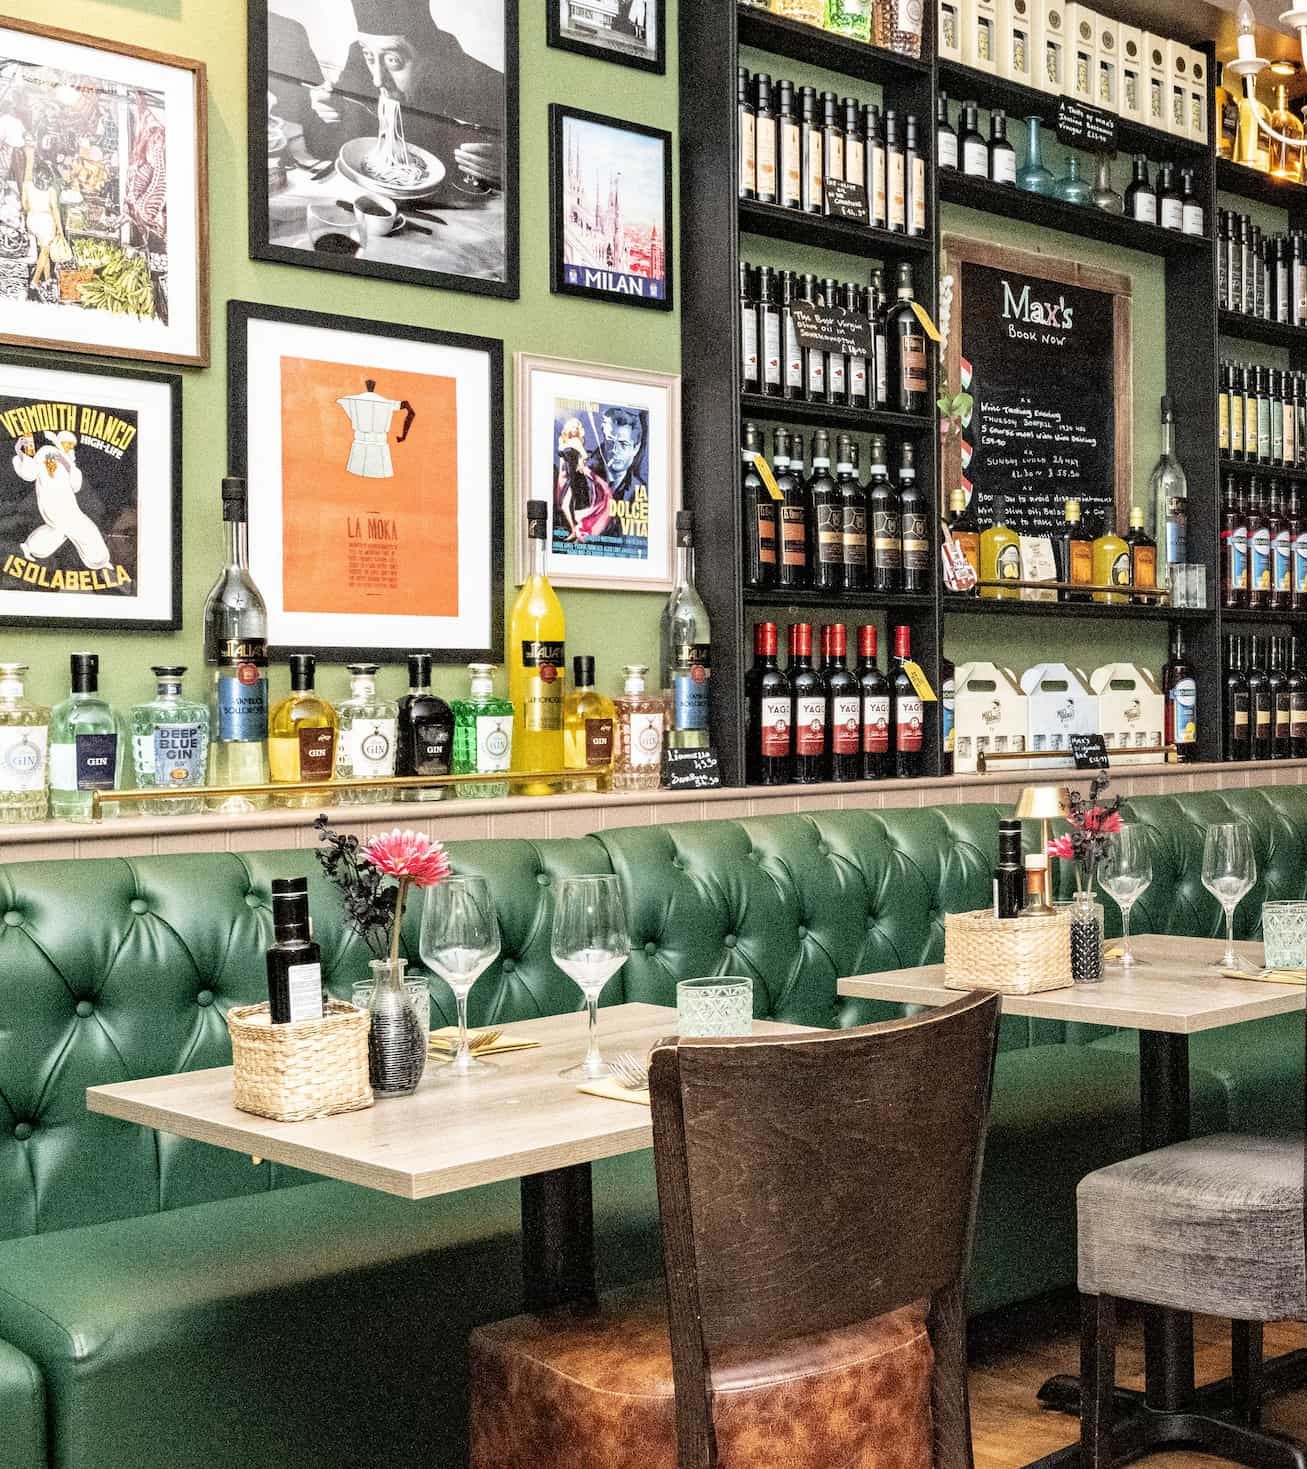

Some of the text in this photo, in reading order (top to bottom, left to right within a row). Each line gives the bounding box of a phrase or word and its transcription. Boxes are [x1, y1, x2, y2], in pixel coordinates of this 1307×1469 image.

[584, 268, 644, 297] MILAN
[1001, 281, 1074, 329] Max's
[0, 403, 136, 451] VERMOUTH BIANCO
[81, 435, 123, 459] HIGH-LIFE
[635, 484, 647, 502] LA
[609, 500, 648, 520] DOLCE
[347, 517, 398, 540] LA MOKA
[621, 517, 648, 536] VITA
[3, 554, 132, 591] ISOLABELLA
[160, 728, 197, 739] DEEP
[592, 737, 608, 745] GIN
[159, 738, 198, 749] BLUE
[366, 746, 385, 754] GIN
[426, 746, 443, 754] GIN
[87, 757, 108, 766] GIN
[166, 749, 193, 760] GIN
[309, 749, 326, 758] GIN
